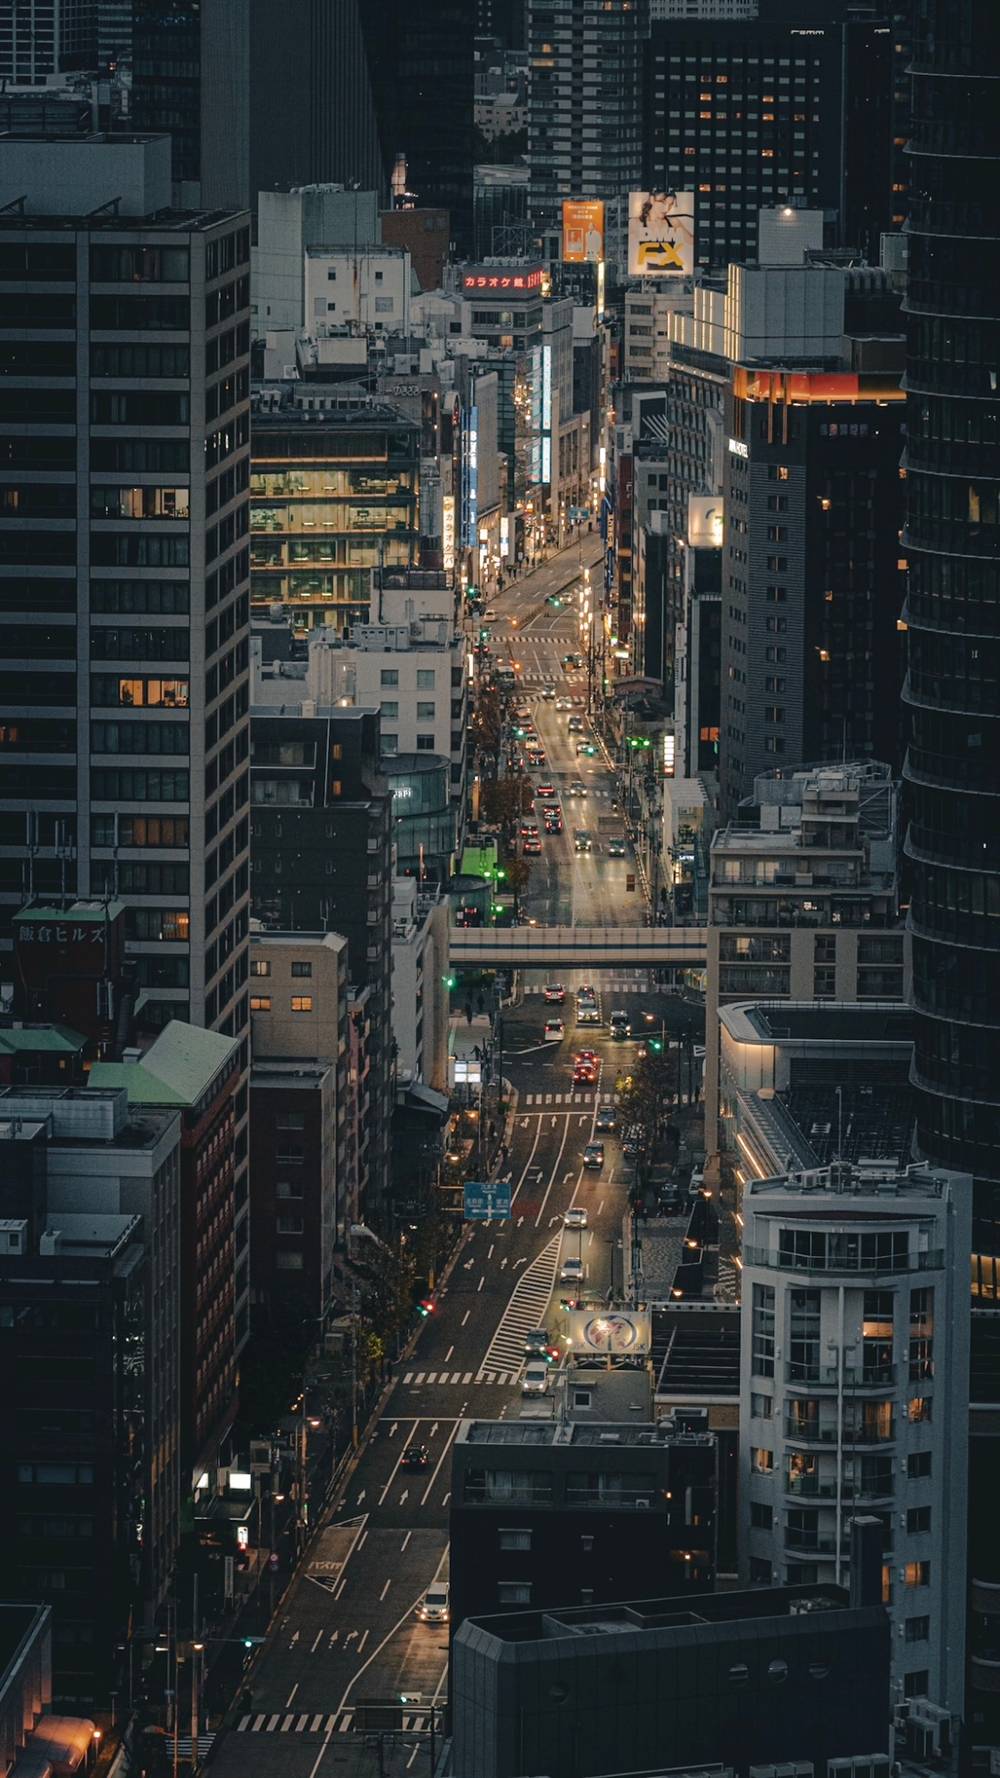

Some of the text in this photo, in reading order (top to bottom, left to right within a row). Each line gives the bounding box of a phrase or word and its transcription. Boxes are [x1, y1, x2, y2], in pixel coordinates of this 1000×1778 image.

[638, 242, 684, 266] FX
[19, 925, 105, 943] 飯倉ヒルズ
